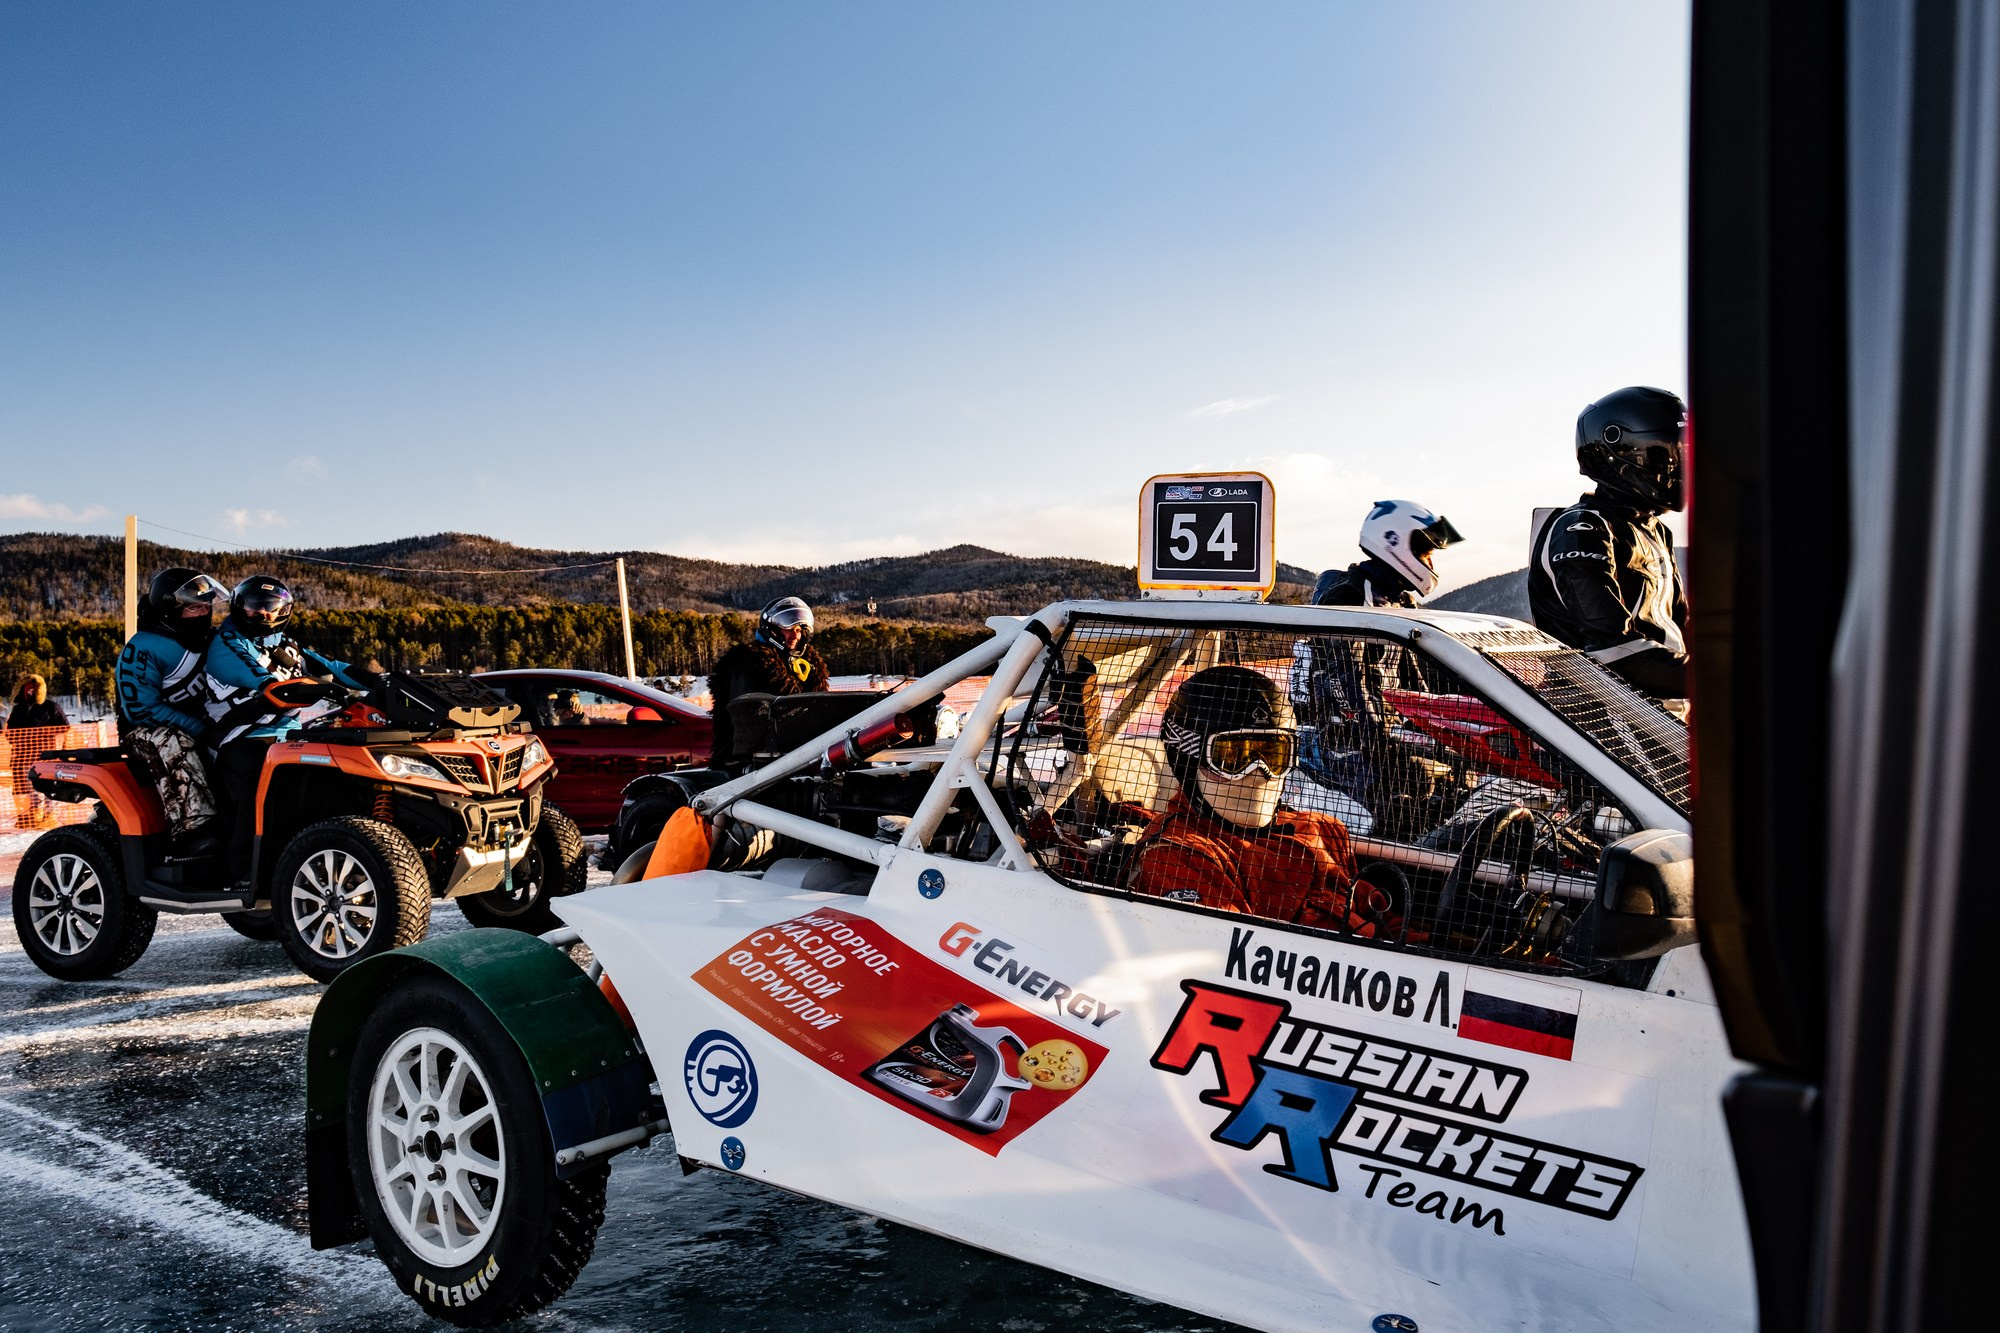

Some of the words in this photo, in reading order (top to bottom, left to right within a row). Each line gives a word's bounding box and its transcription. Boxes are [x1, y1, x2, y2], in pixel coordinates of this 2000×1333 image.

[1169, 512, 1238, 562] 54
[54, 763, 83, 772] CFMOTO
[750, 932, 775, 947] С
[764, 943, 845, 999] УМНОЙ
[773, 922, 847, 969] МАСЛО
[796, 915, 900, 976] МОТОРНОЕ
[728, 949, 843, 1031] ФОРМУЛОЙ
[1224, 926, 1418, 1018] Качалков
[1422, 970, 1458, 1030] Л.
[828, 1051, 845, 1063] 18+
[1153, 982, 1524, 1118] RUSSIAN
[1216, 1062, 1635, 1214] ROCKETS
[1359, 1163, 1506, 1236] Team
[414, 1253, 500, 1308] PIRELLI
